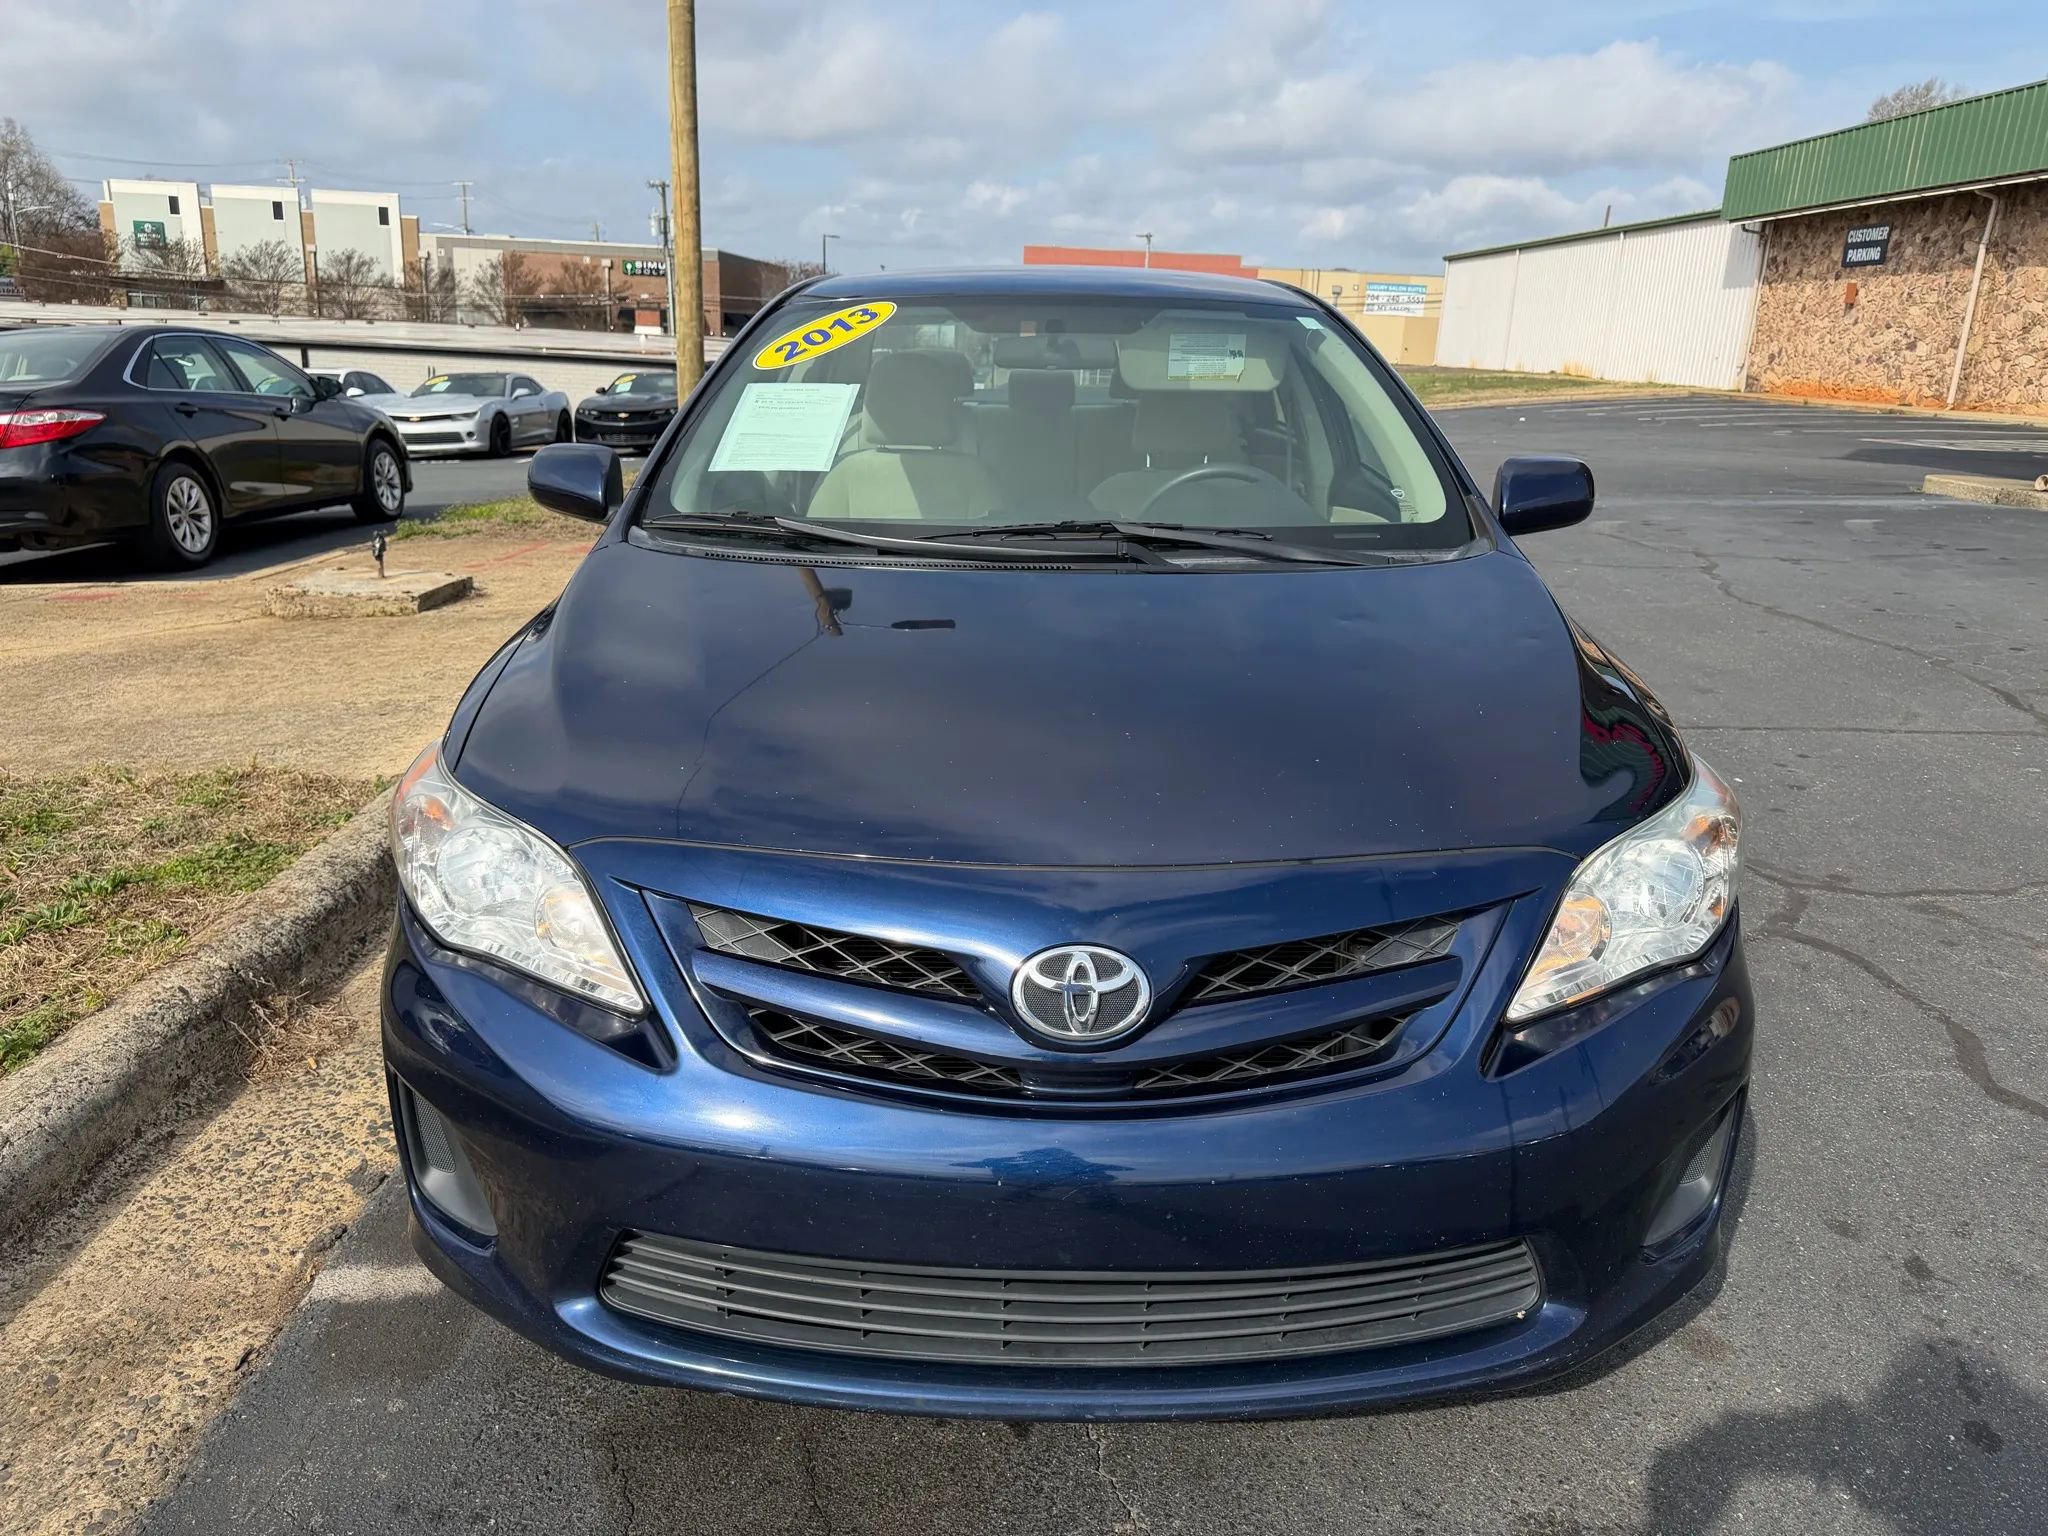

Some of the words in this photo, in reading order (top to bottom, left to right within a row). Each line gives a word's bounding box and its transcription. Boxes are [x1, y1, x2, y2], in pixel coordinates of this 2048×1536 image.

[1848, 226, 1889, 243] CUSTOMER
[1846, 246, 1881, 262] PARKING
[635, 260, 666, 270] SIMU
[774, 308, 880, 362] 2013
